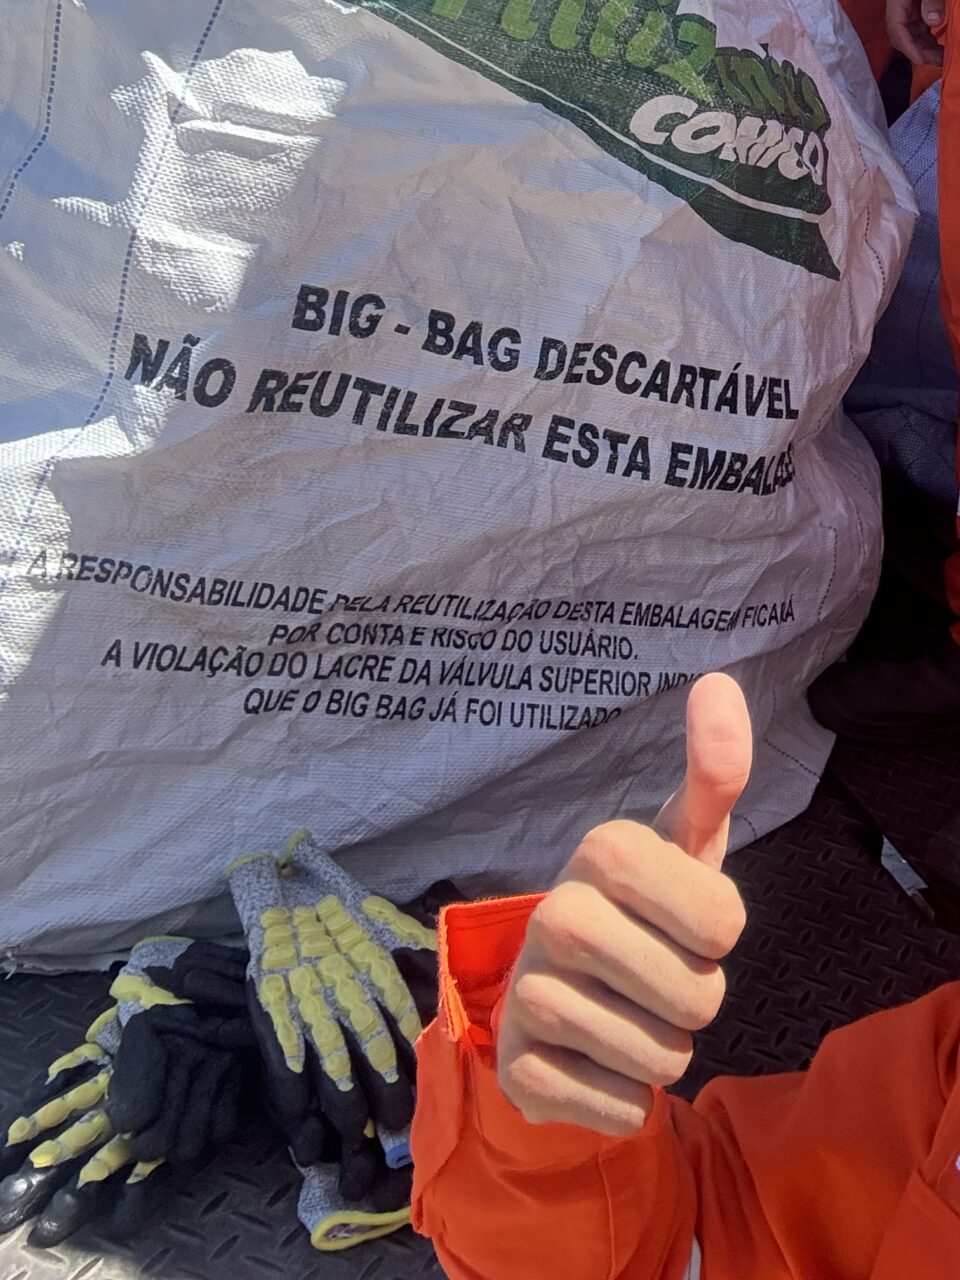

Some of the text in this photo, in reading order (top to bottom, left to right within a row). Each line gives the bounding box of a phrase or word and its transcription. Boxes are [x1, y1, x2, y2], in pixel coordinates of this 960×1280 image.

[291, 283, 386, 339] BIG
[421, 308, 521, 371] BAG
[533, 336, 799, 420] DESCARTÁVEL
[124, 332, 237, 408] NÃO
[246, 368, 533, 453] REUTILIZAR
[541, 414, 650, 481] ESTA
[58, 553, 328, 614] RESPONSABILIDADE
[329, 593, 391, 614] PELA
[393, 593, 552, 625] REUTILIZAÇÃO
[552, 600, 615, 624] DESTA
[619, 601, 741, 633] EMBALAGEM
[741, 594, 795, 628] FICARÁ
[100, 639, 122, 667] A
[132, 641, 265, 678] VIOLAÇÃO
[267, 651, 308, 679] DO
[313, 652, 396, 682] LACRE
[398, 657, 431, 686] DA
[438, 655, 533, 691] VÁLVULA
[539, 665, 651, 697] SUPERIOR
[268, 622, 638, 660] POR CONTA E RISCO DO USUÁRIO.
[243, 687, 299, 715] QUE
[302, 689, 321, 712] O
[325, 688, 370, 718] BIG
[375, 694, 427, 721] BAG
[428, 690, 457, 723] JÁ
[464, 698, 503, 727] FOI
